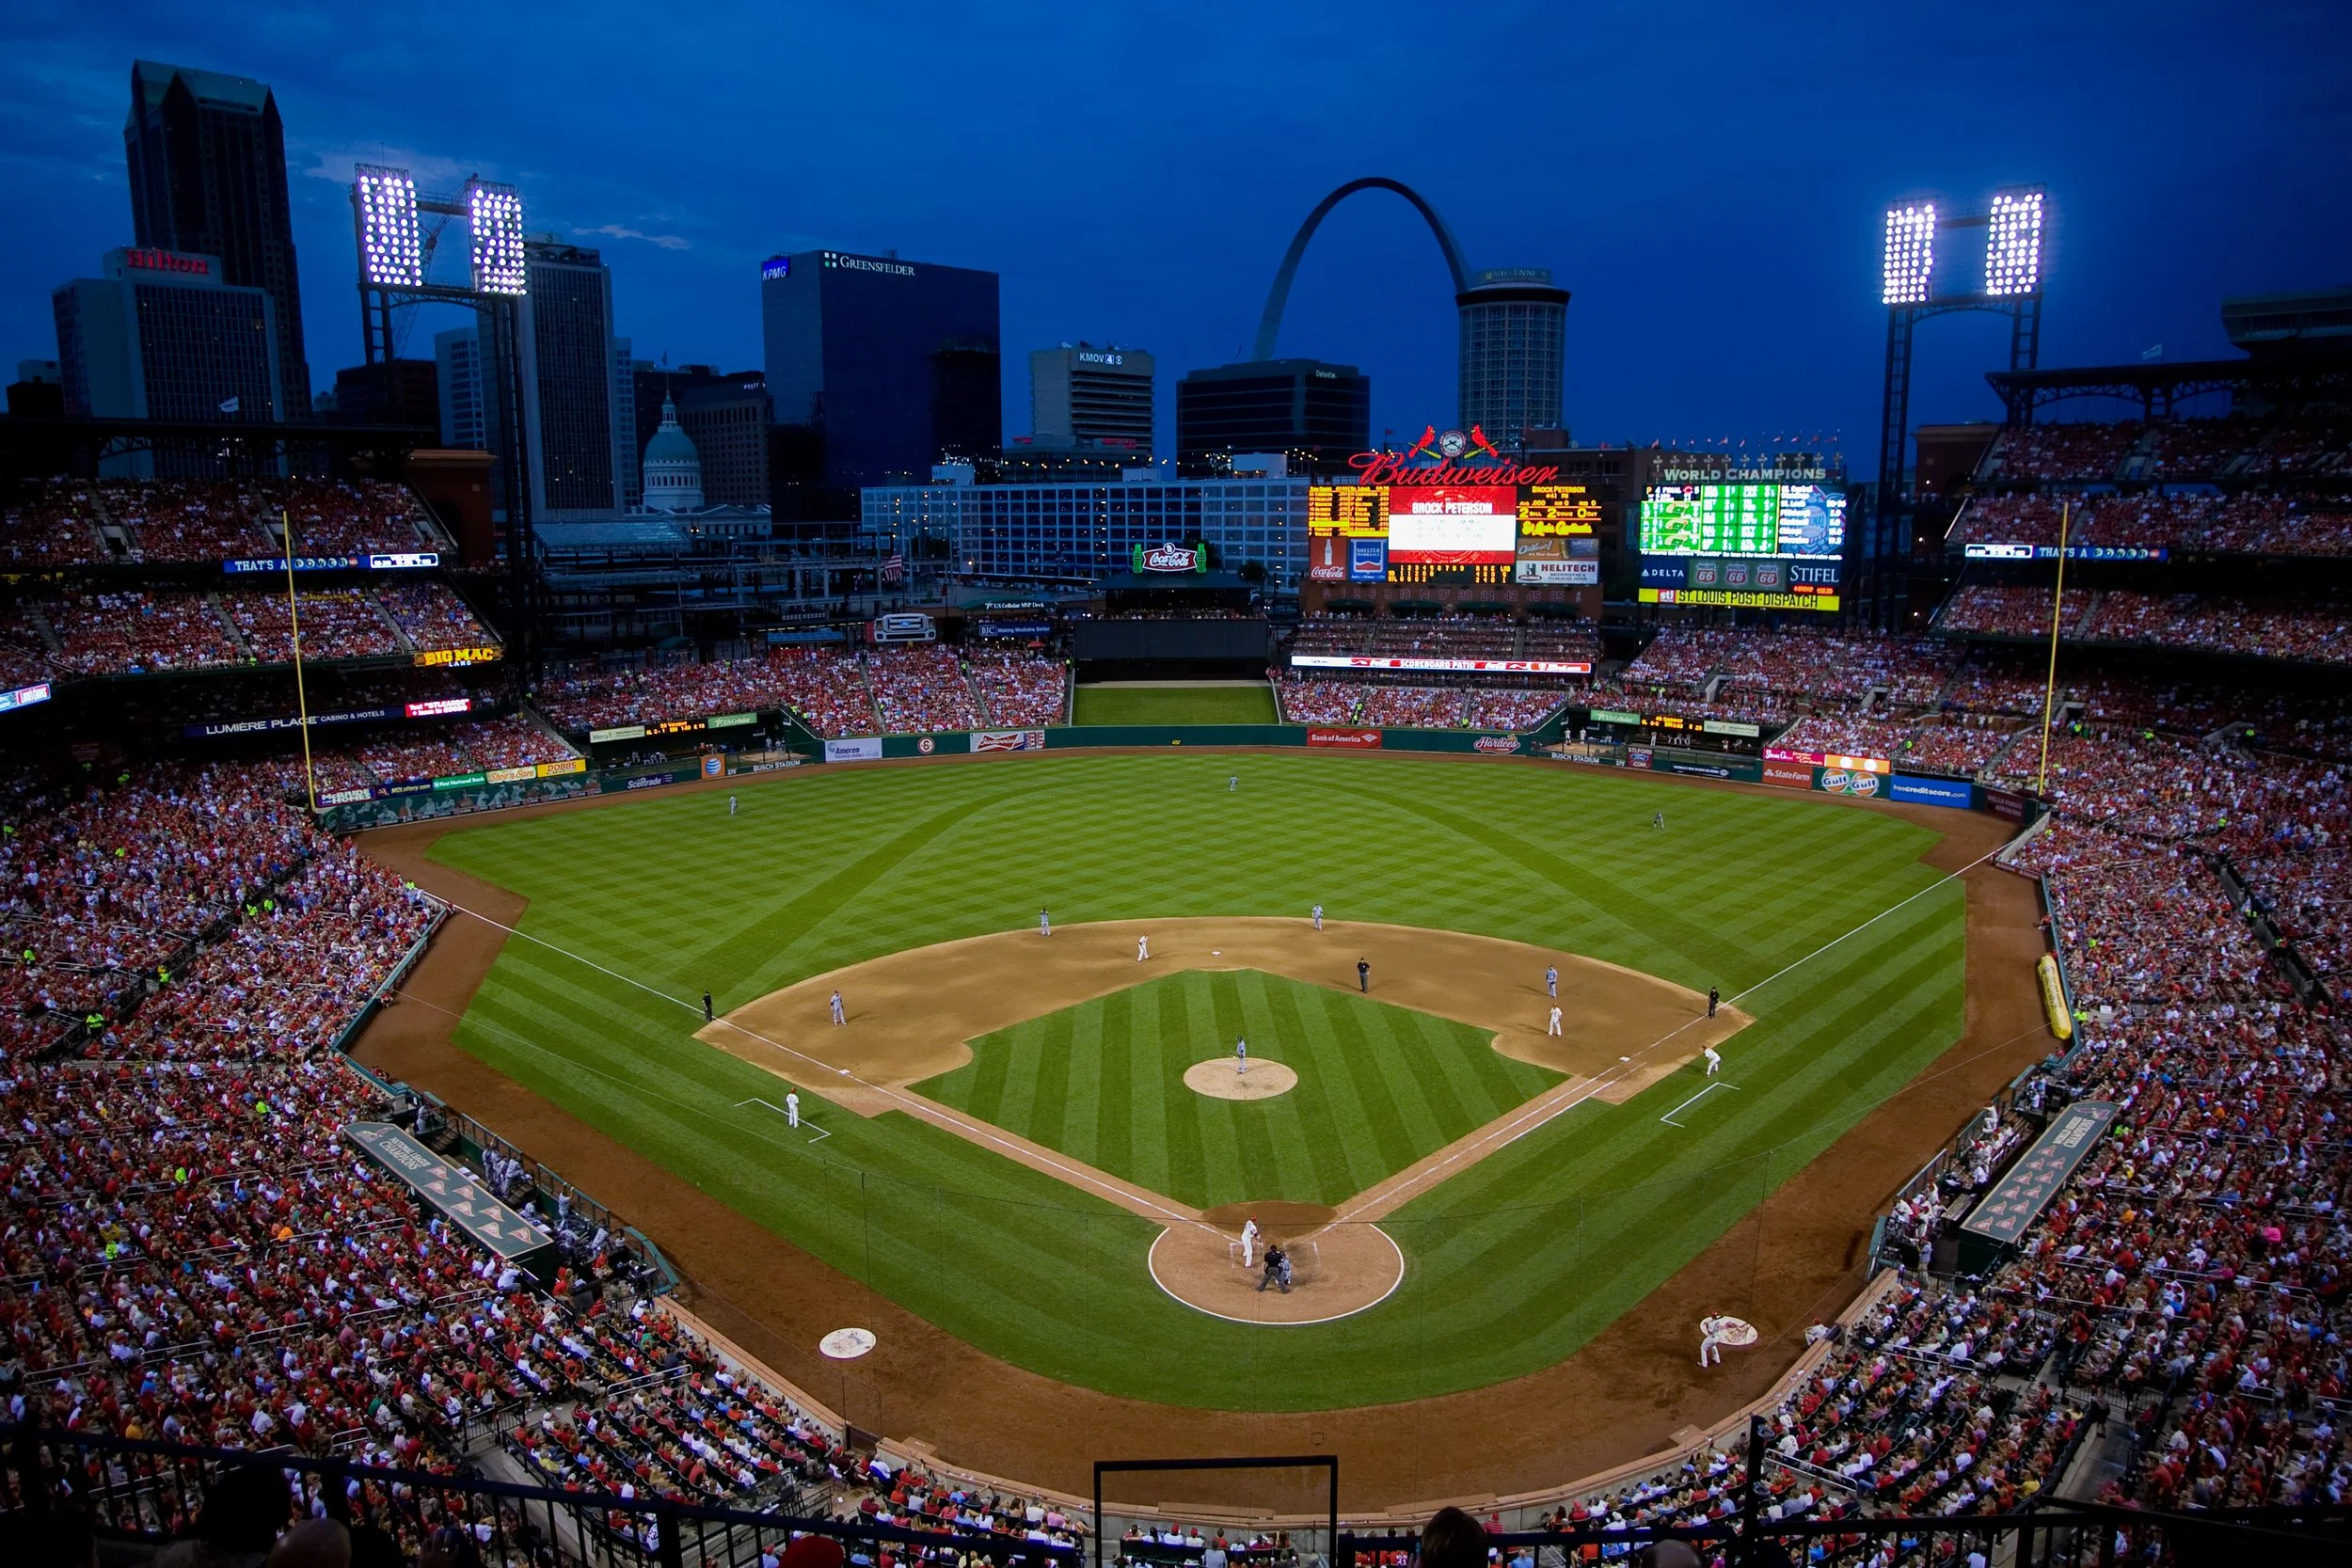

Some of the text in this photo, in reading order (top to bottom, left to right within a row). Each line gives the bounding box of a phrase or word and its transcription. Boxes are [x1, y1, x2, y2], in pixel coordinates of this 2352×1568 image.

[126, 248, 210, 275] Hilton
[840, 256, 915, 277] GREENSFELDER
[762, 265, 787, 281] KPMG
[1079, 353, 1104, 363] KMOV
[1348, 452, 1560, 485] Budweiser
[1664, 468, 1827, 481] WORLD CHAMPIONS
[1411, 502, 1493, 515] BROCK PETERSON
[1519, 506, 1529, 518] 2
[1547, 506, 1557, 518] 2
[1577, 507, 1587, 518] 0
[2079, 547, 2088, 558] A
[235, 560, 274, 572] THAT'S
[279, 559, 288, 570] A
[294, 557, 348, 568] POWER
[1541, 564, 1596, 573] HELITECH
[1652, 569, 1684, 578] DELTA
[1698, 571, 1713, 580] 66
[1728, 572, 1743, 581] 66
[1759, 574, 1774, 583] 66
[1789, 565, 1839, 582] STIFEL
[1353, 587, 1360, 599] 2
[1384, 588, 1391, 600] 9
[1419, 589, 1429, 600] 14
[1438, 589, 1450, 600] 17
[1457, 589, 1472, 600] 20
[1480, 589, 1495, 601] 24
[1504, 590, 1518, 601] 42
[1526, 590, 1542, 602] 45
[1678, 591, 1818, 608] ST. LOUIS POST-DISPATCH
[980, 626, 995, 635] BJC
[423, 648, 494, 666] BIG MAC
[1400, 659, 1475, 669] SCOREBOARD PATIO
[271, 716, 317, 729] PLACE
[320, 713, 348, 721] CASINO
[357, 710, 385, 719] HOTELS
[1707, 723, 1722, 732] Mercy
[593, 732, 610, 740] Mercy
[923, 739, 930, 751] 6
[1551, 752, 1599, 764] BUSCH STADIUM
[547, 761, 577, 771] DOBBS
[754, 759, 801, 772] BUSCH STADIUM
[489, 772, 507, 783] Shop
[516, 769, 534, 779] Save
[1774, 769, 1811, 781] State Farm
[1823, 776, 1847, 785] Gulf
[450, 778, 470, 786] National
[628, 776, 661, 789] Scottrade
[1851, 779, 1876, 789] Gulf
[1893, 784, 1966, 799] freecreditscore.com
[379, 1140, 421, 1170] CHAMPIONS
